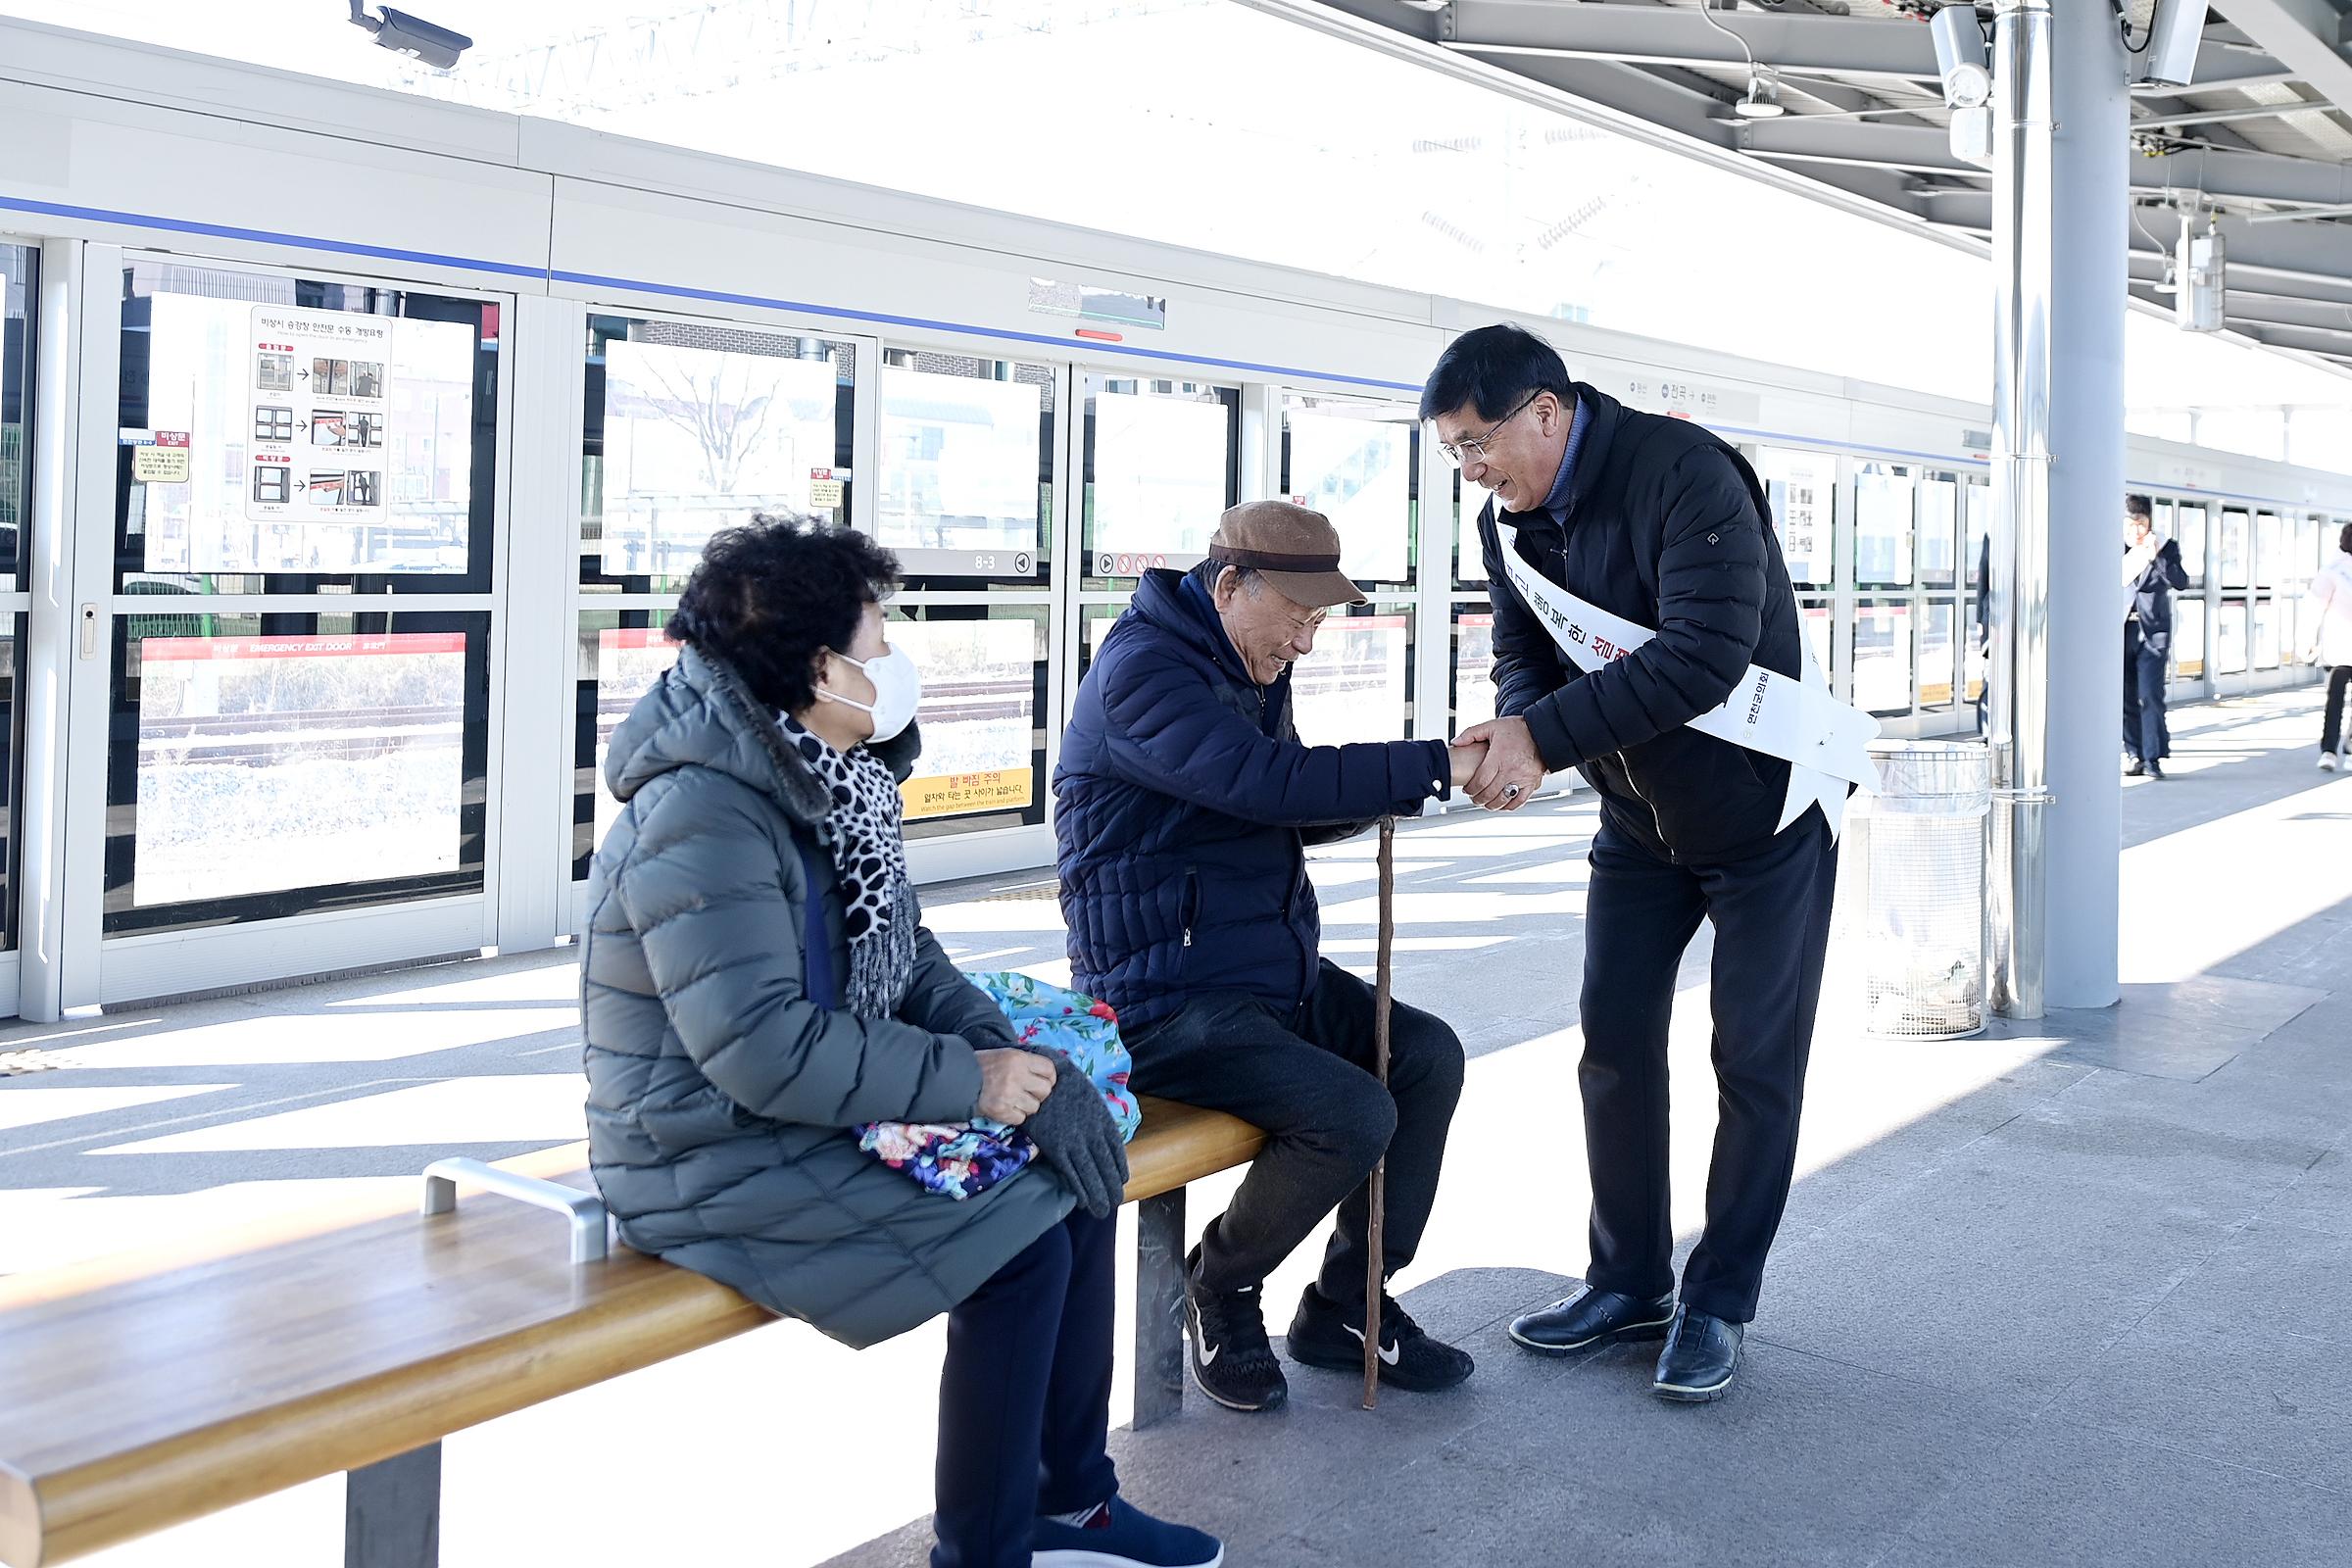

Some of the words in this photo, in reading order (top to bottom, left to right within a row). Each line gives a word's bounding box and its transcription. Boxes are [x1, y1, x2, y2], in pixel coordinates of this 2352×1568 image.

[161, 432, 185, 441] 비상문
[975, 555, 995, 569] 8-3
[250, 643, 304, 652] EMERGENCY
[325, 642, 352, 651] DOOR
[1747, 672, 1769, 724] 연천군의회
[950, 776, 957, 788] 발
[984, 772, 1001, 784] 주의
[924, 792, 945, 803] 열차와
[948, 791, 960, 801] 타는
[964, 790, 970, 800] 곳
[974, 787, 994, 798] 사이가
